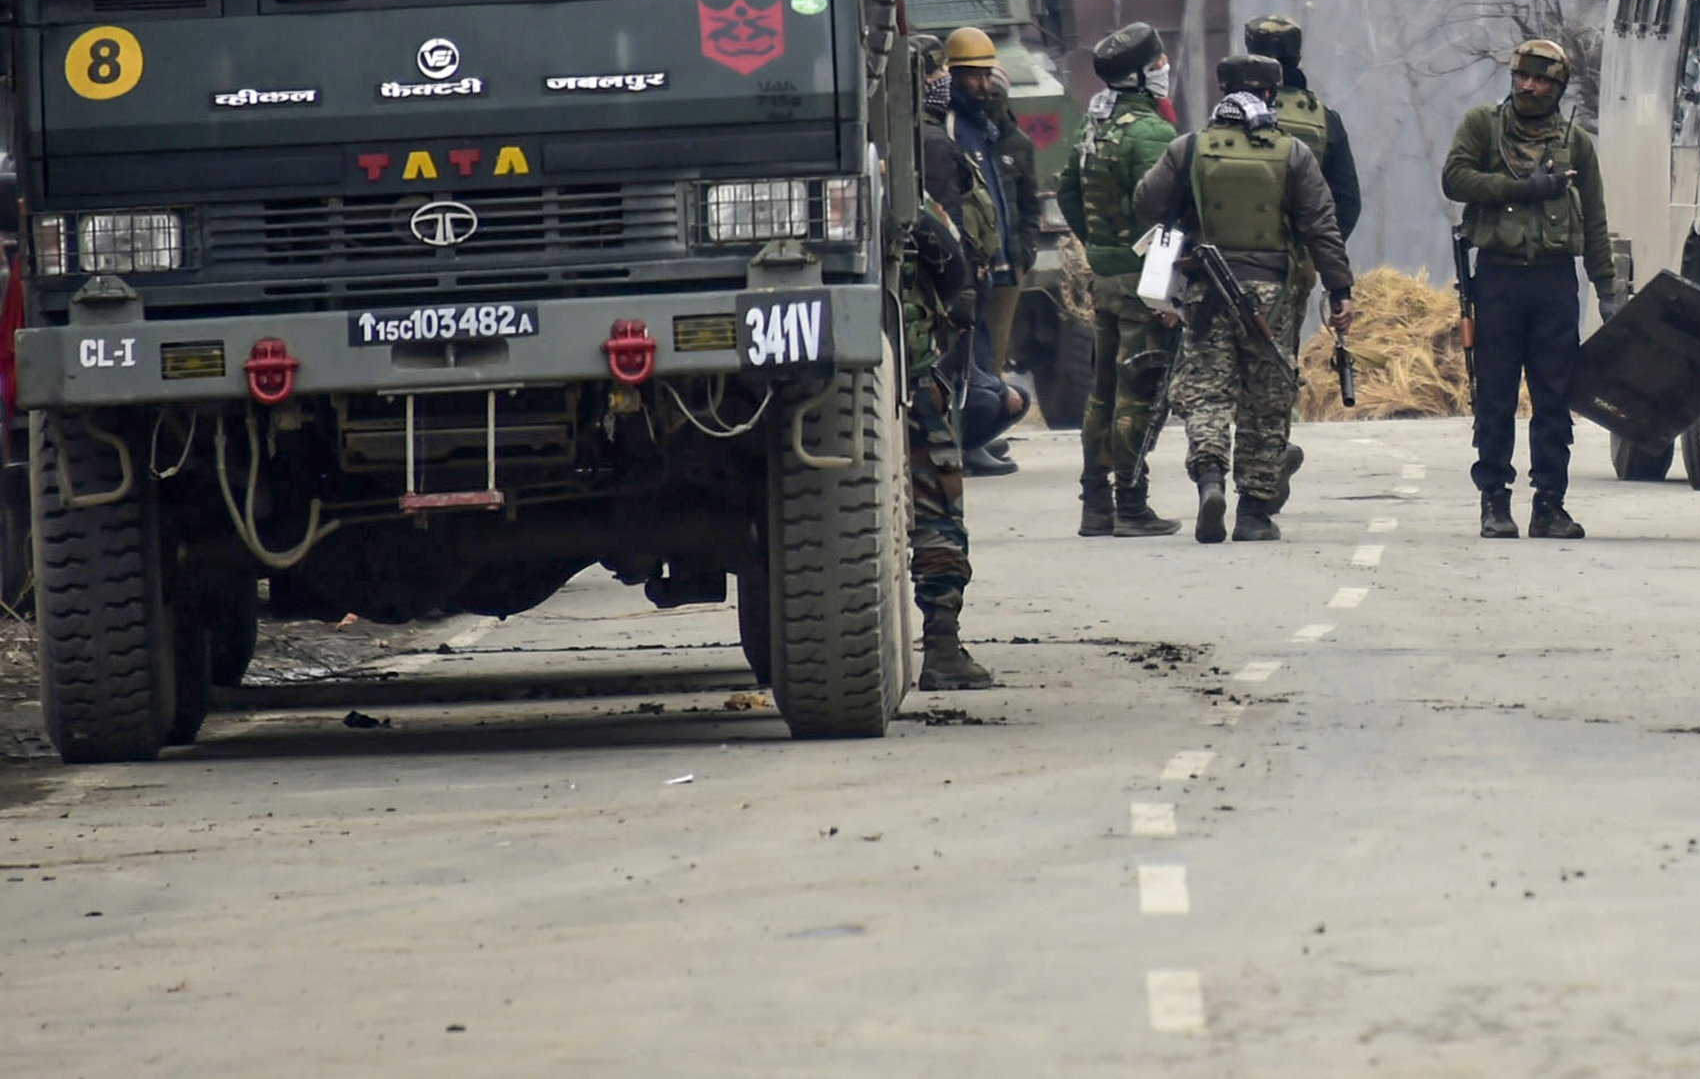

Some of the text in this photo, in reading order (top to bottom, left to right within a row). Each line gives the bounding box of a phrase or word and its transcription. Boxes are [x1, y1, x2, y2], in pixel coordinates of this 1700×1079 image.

[87, 37, 122, 85] 8
[214, 88, 317, 106] व्हीकल
[546, 72, 665, 91] जबलपुर
[357, 146, 530, 181] TATA
[745, 300, 822, 367] 341V
